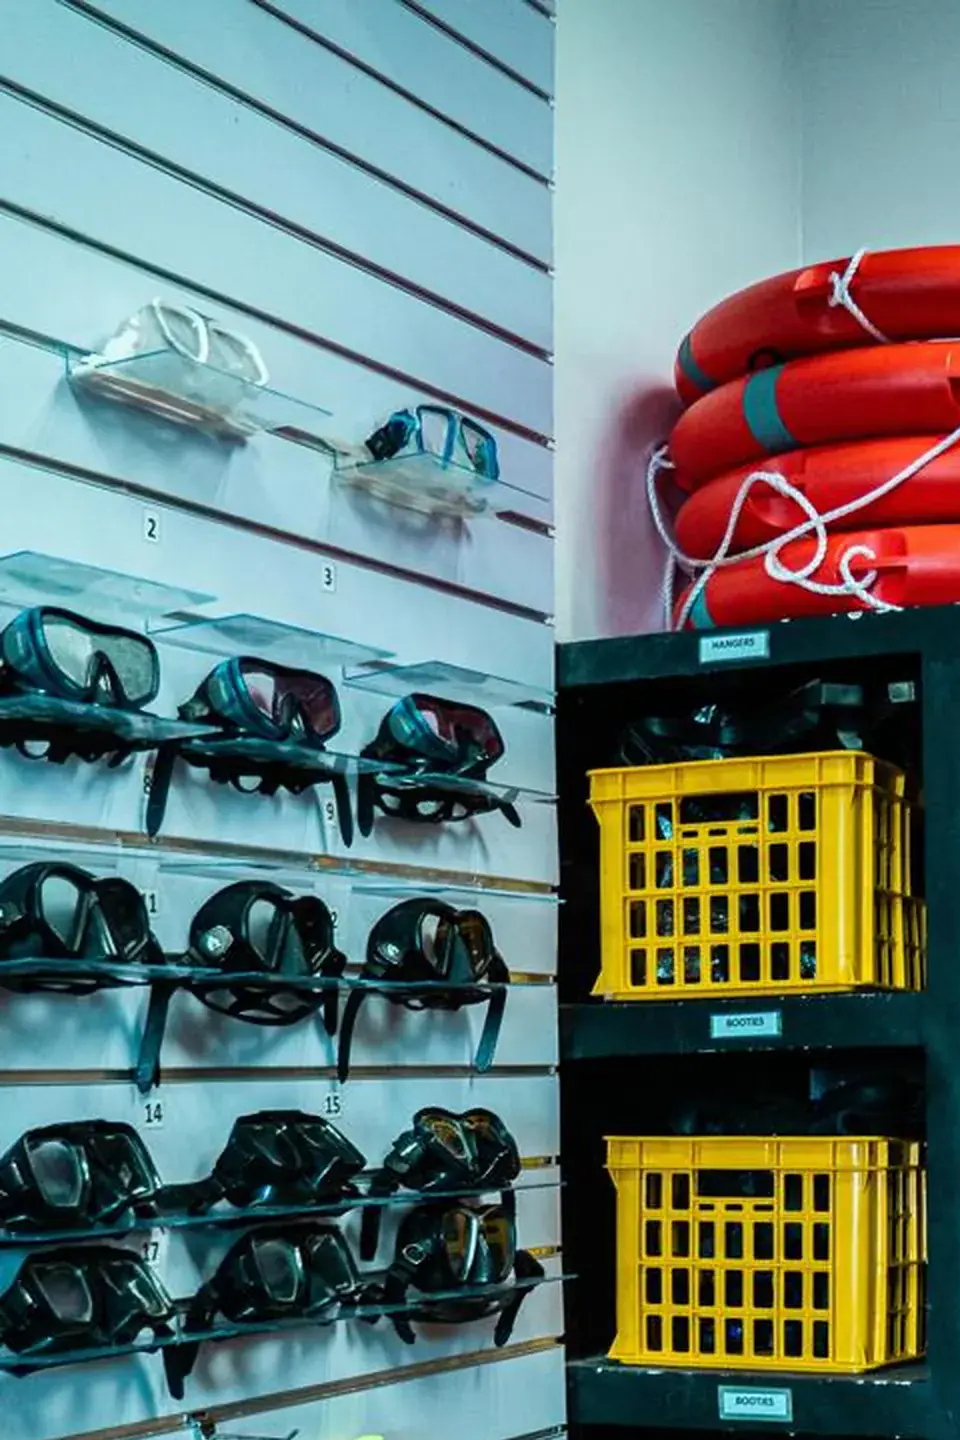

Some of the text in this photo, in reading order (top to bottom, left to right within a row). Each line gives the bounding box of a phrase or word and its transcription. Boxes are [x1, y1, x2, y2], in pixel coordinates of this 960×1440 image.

[147, 517, 157, 539] 2
[324, 567, 333, 586] 3
[712, 637, 755, 650] HANGERS
[325, 801, 334, 821] 9
[726, 1016, 765, 1028] BOOTIES
[145, 1102, 162, 1123] 14
[325, 1096, 341, 1114] 15
[142, 1241, 159, 1261] 17
